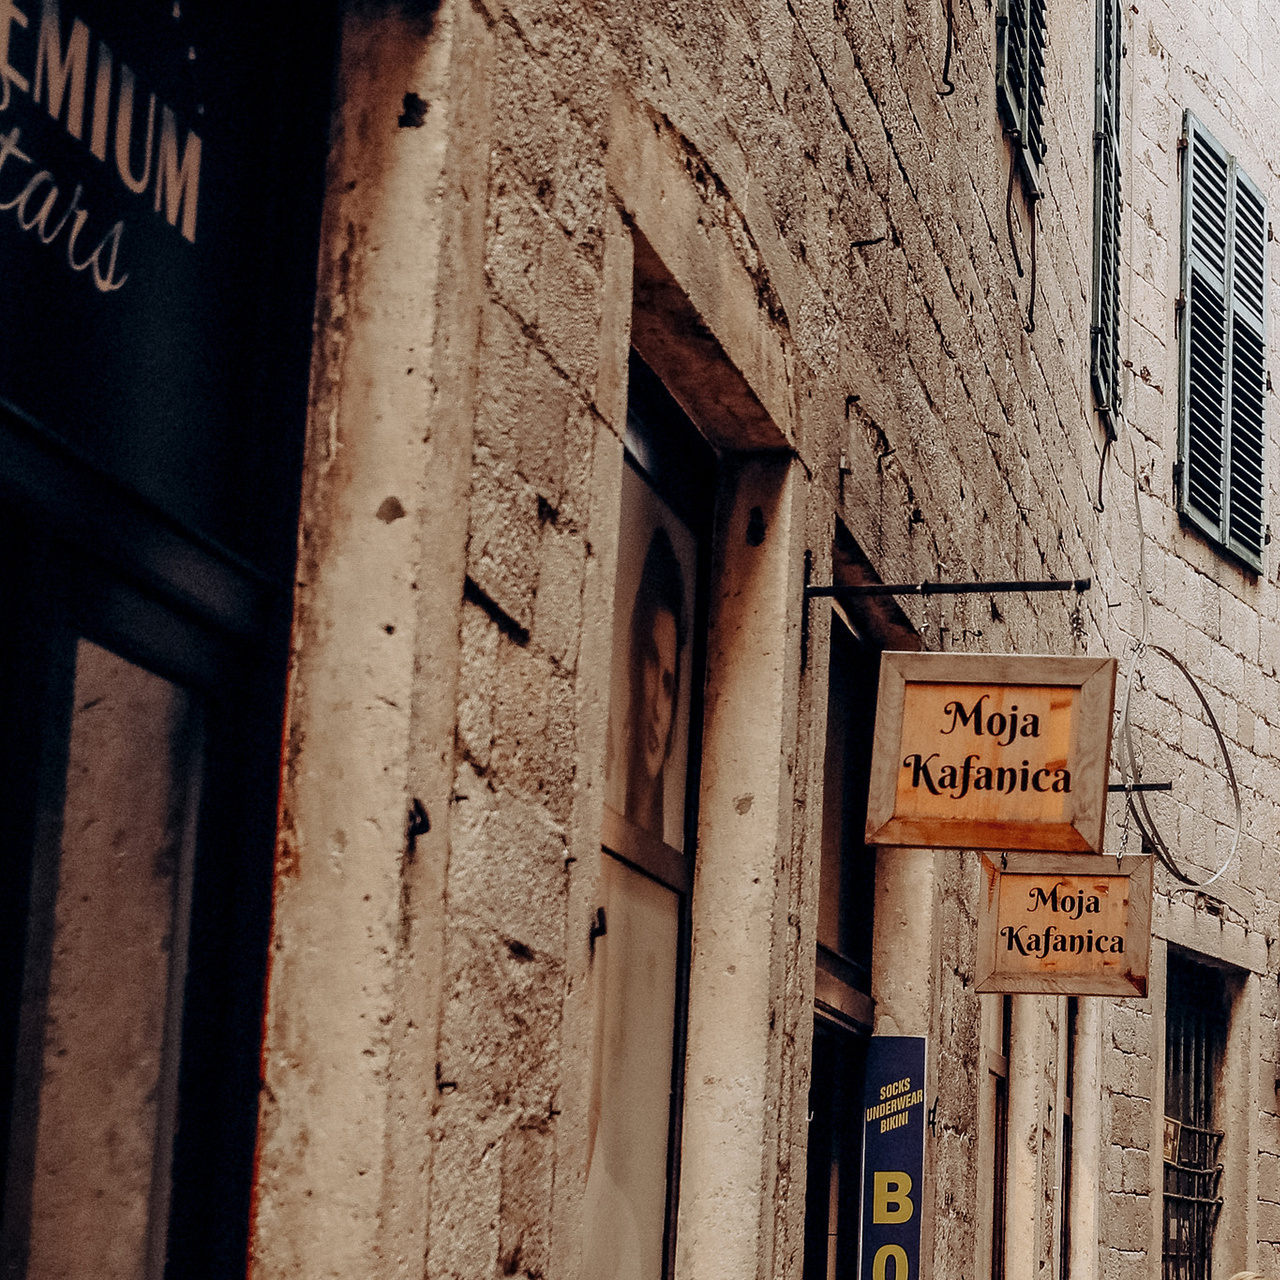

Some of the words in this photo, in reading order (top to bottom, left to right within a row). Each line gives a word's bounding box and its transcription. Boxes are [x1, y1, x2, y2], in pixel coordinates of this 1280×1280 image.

[940, 694, 1041, 747] Moja
[903, 753, 1073, 800] Kafanica
[1026, 882, 1101, 920] Moja
[1000, 925, 1125, 959] Kafanica
[866, 1089, 923, 1122] UNDERWEAR
[880, 1077, 911, 1100] SOCKS
[880, 1111, 909, 1134] BIKINI
